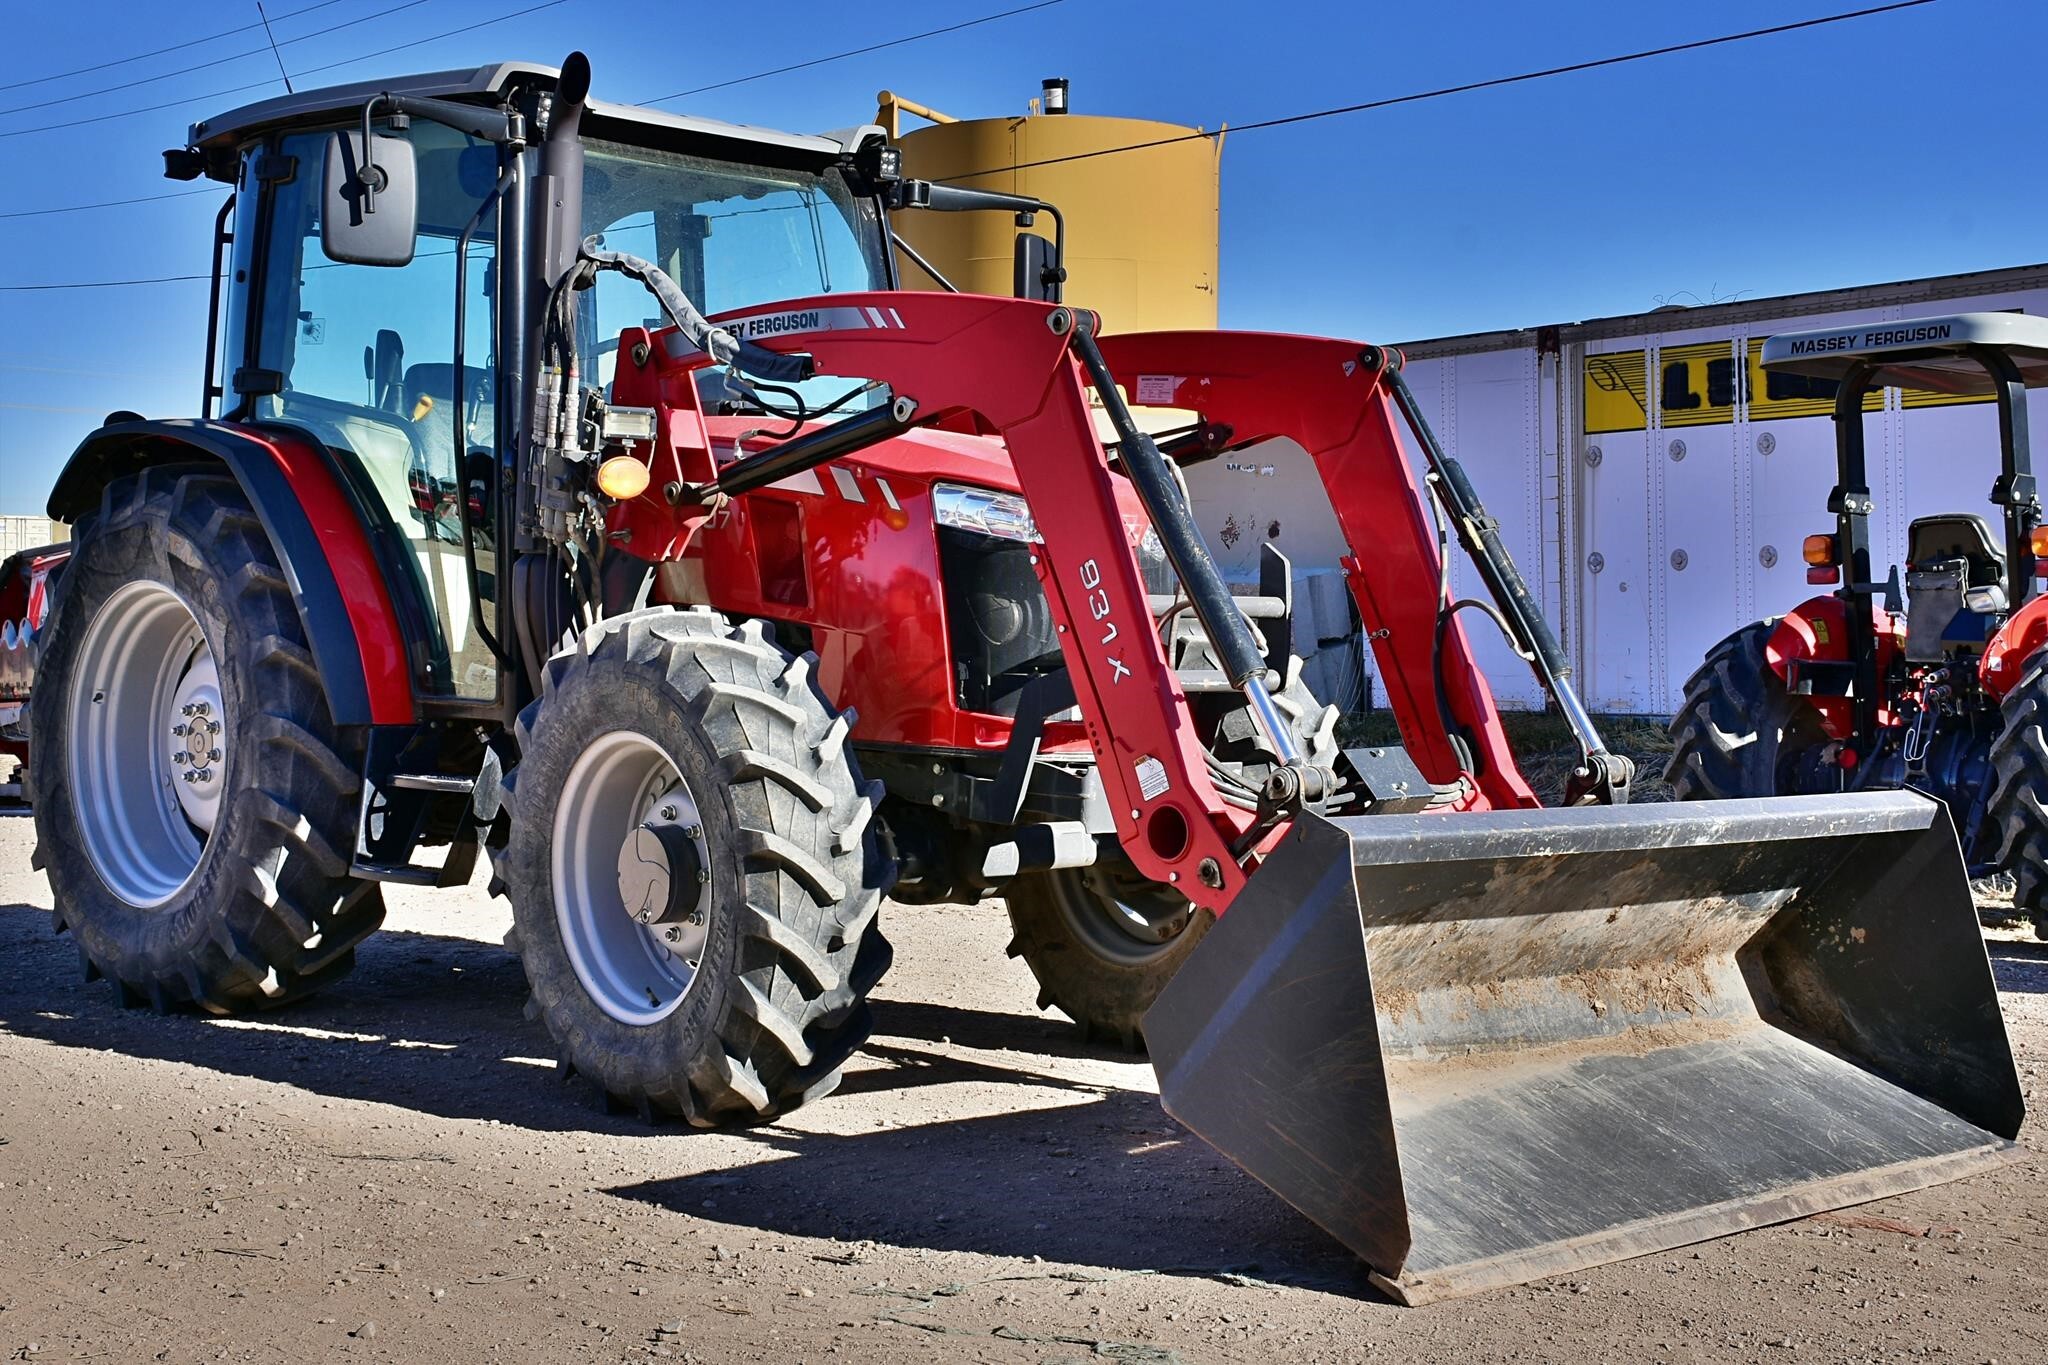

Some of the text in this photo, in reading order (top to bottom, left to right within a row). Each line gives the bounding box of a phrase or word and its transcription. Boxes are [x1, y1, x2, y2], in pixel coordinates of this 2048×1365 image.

[749, 312, 819, 336] FERGUSON
[1791, 325, 1951, 354] MASSEY FERGUSON
